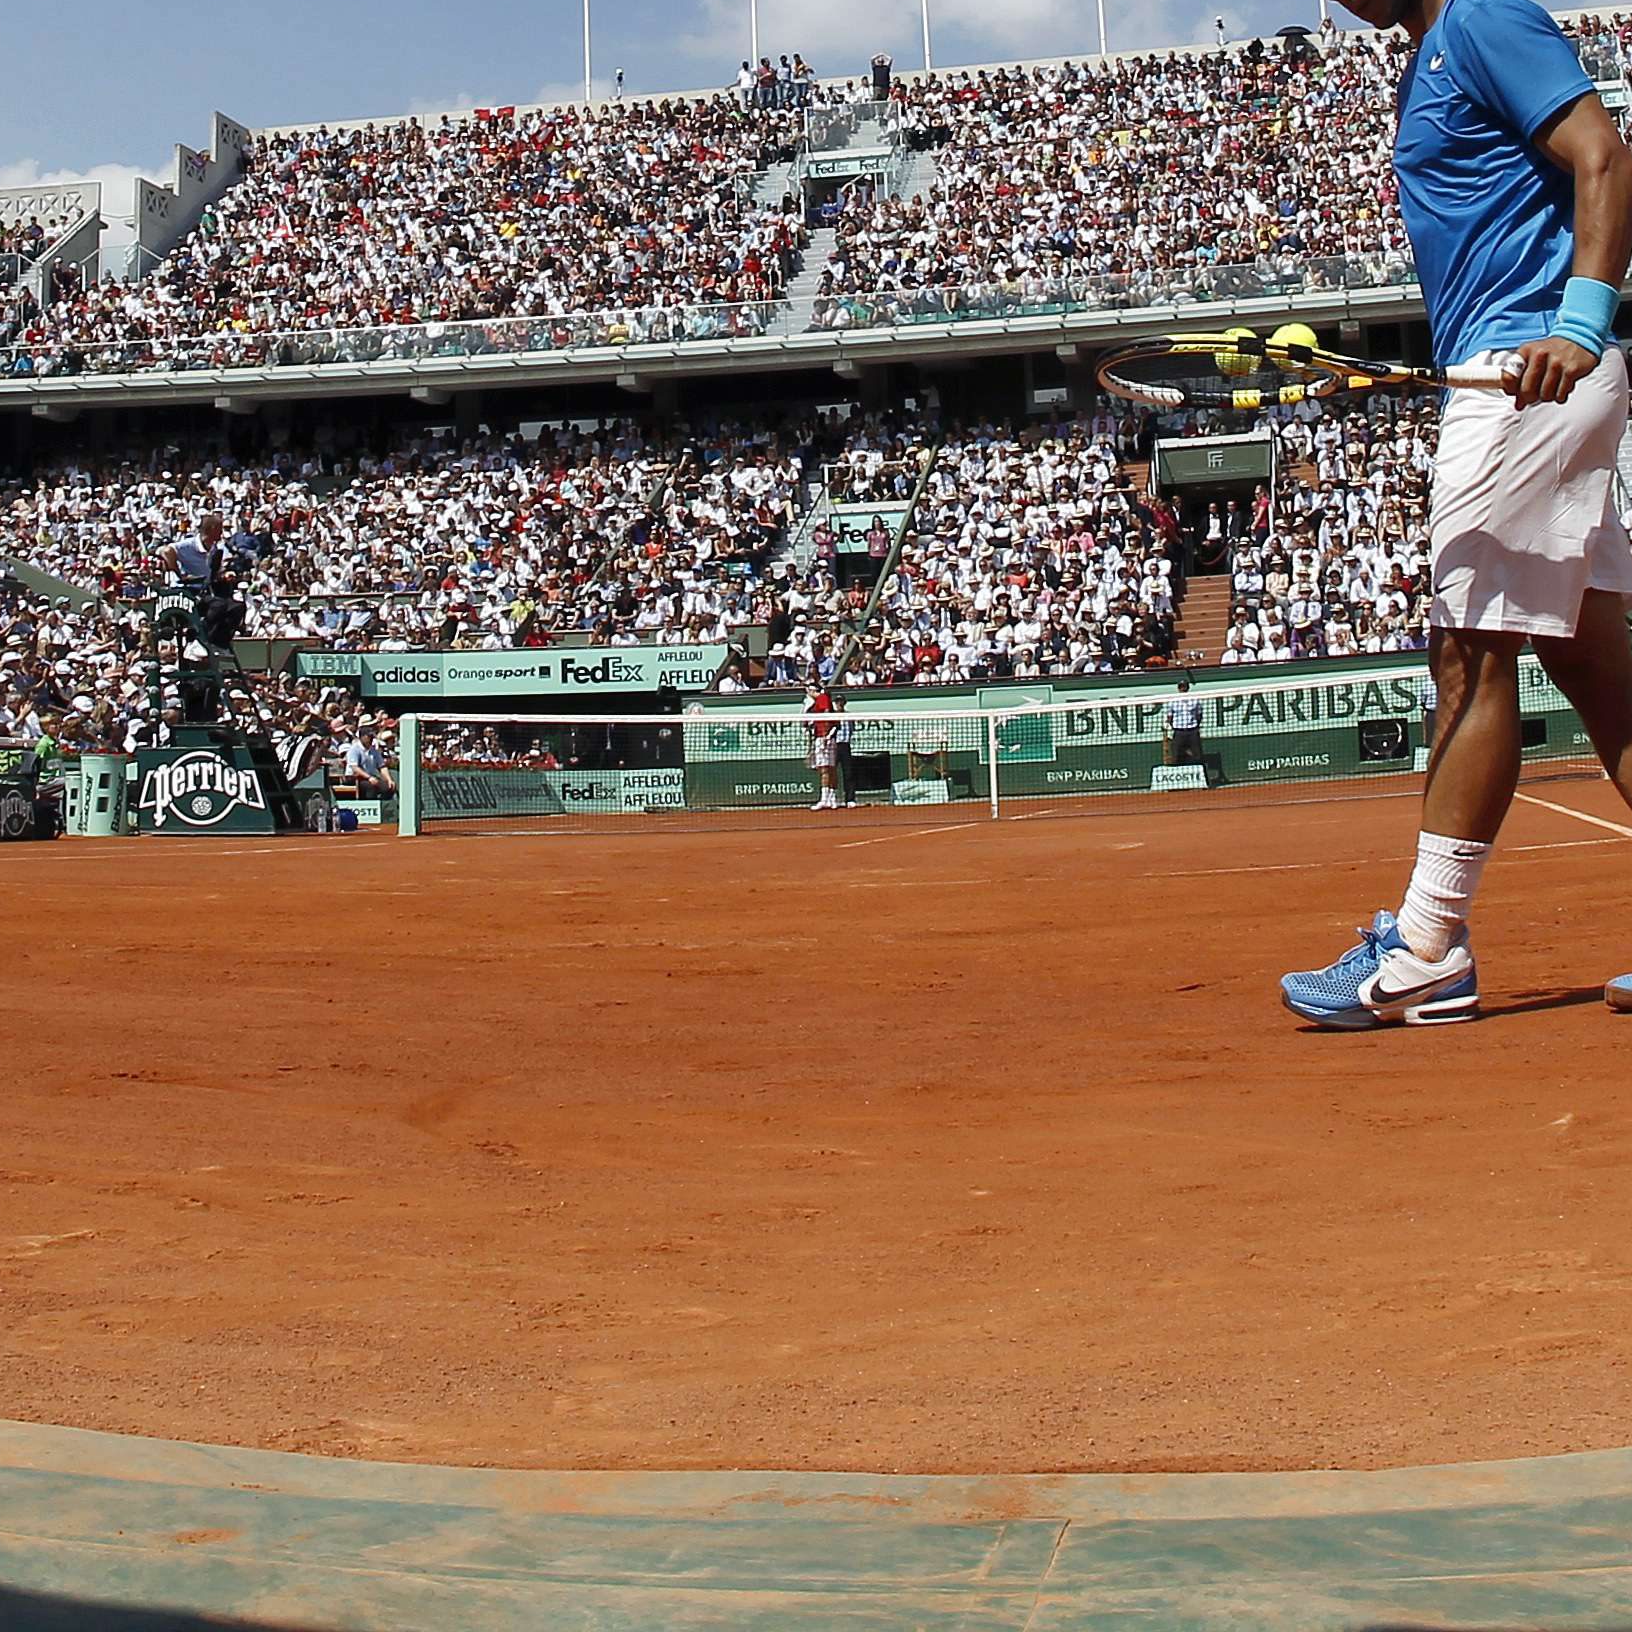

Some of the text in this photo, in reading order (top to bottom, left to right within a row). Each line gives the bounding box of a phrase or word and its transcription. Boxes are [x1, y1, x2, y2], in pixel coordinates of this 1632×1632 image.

[311, 654, 358, 674] IBM
[657, 651, 703, 663] AFFLELOU
[372, 656, 643, 684] adidas Orange sport FedEx
[1065, 677, 1418, 737] BNP PARIBAS
[1247, 753, 1331, 771] BNP PARIBAS
[623, 774, 681, 788] AFFLELOU
[1046, 767, 1129, 783] BNP PARIBAS
[561, 782, 617, 801] FedEx
[734, 781, 815, 796] BNP PARIBAS
[624, 791, 682, 807] AFFLELOU
